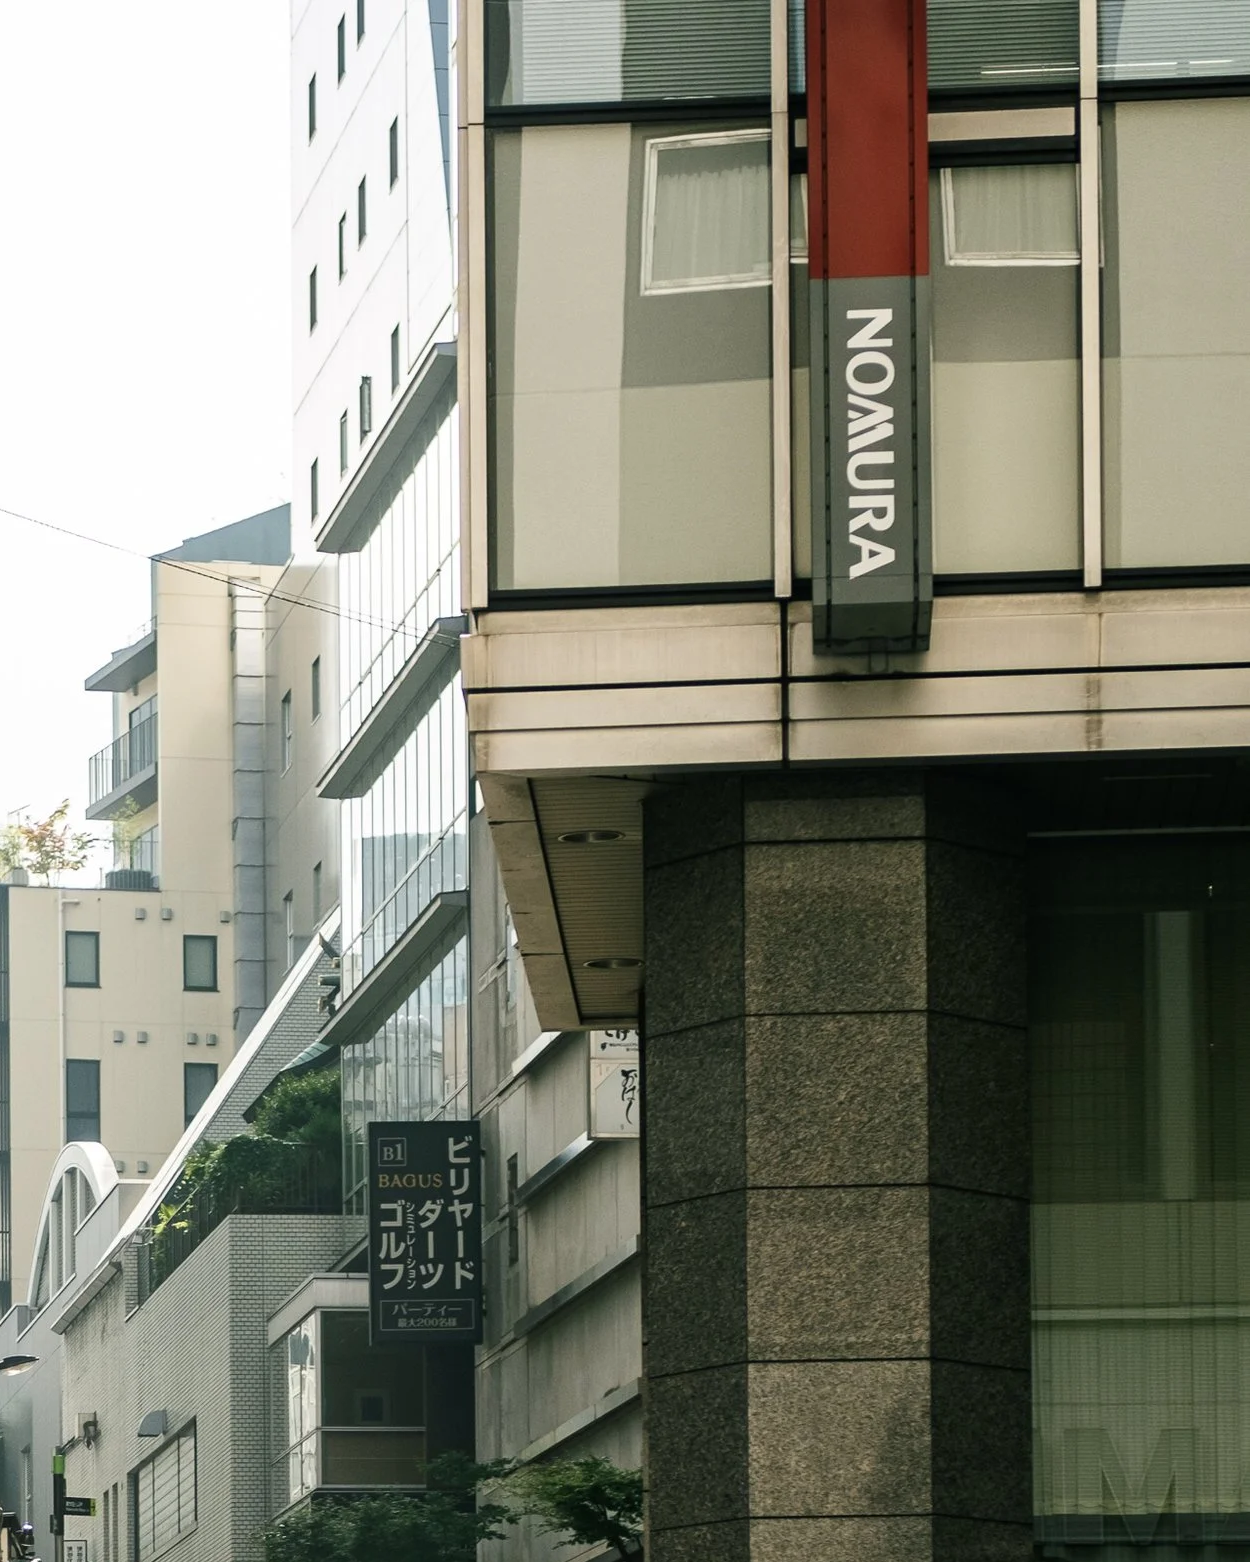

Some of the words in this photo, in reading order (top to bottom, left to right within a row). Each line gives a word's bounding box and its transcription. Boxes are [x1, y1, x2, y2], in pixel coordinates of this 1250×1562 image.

[845, 308, 896, 581] NOMURA
[378, 1173, 444, 1188] BAGUS
[383, 1143, 405, 1161] B1
[379, 1199, 406, 1290] ゴルフ
[406, 1202, 417, 1290] シミュレーション
[418, 1199, 445, 1290] ダーツ
[448, 1135, 474, 1290] ビリヤード
[391, 1303, 463, 1316] パーティー
[397, 1318, 458, 1328] 最大200名様
